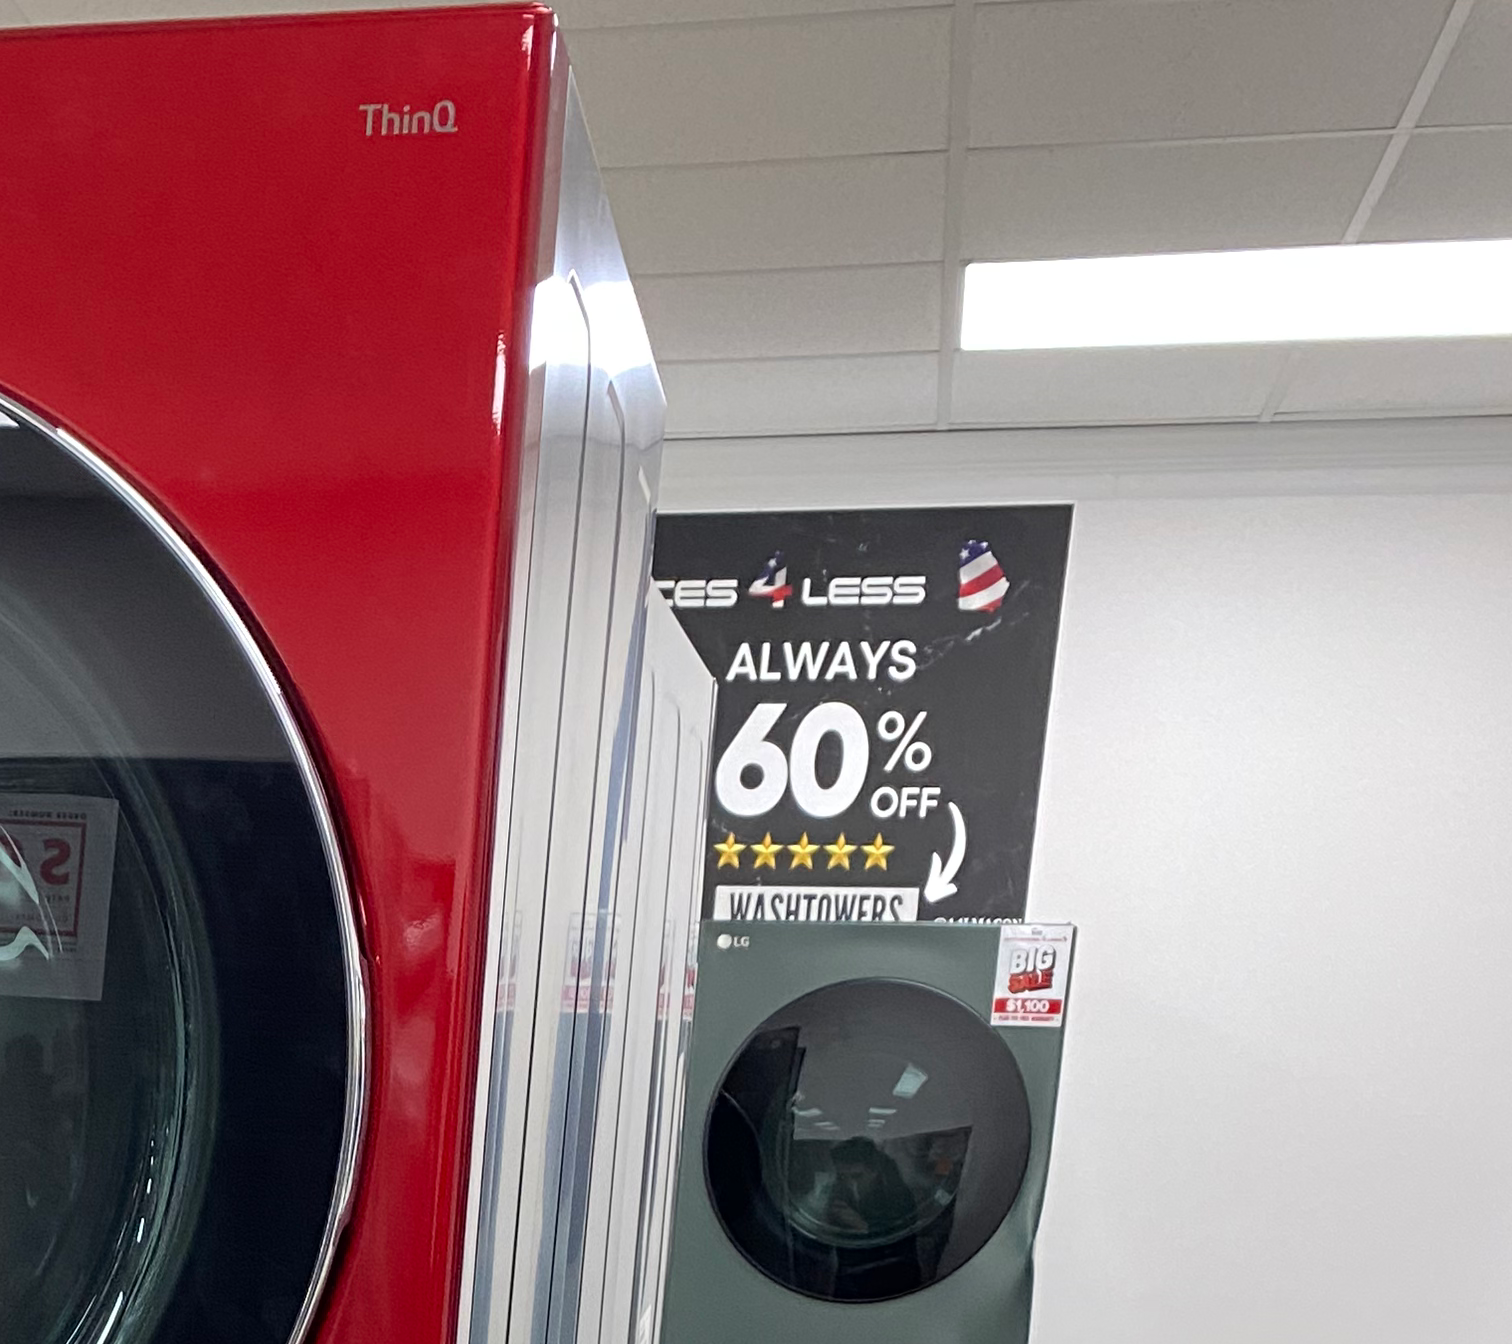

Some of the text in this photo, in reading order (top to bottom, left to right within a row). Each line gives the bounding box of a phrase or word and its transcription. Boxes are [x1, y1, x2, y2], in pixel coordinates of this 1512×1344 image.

[359, 100, 458, 136] ThinQ
[748, 550, 792, 608] 4
[802, 576, 926, 605] LESS
[726, 640, 917, 681] ALWAYS
[871, 786, 940, 818] OFF
[733, 936, 750, 947] LG
[1009, 944, 1056, 975] BIG
[1006, 999, 1050, 1013] $1,100
